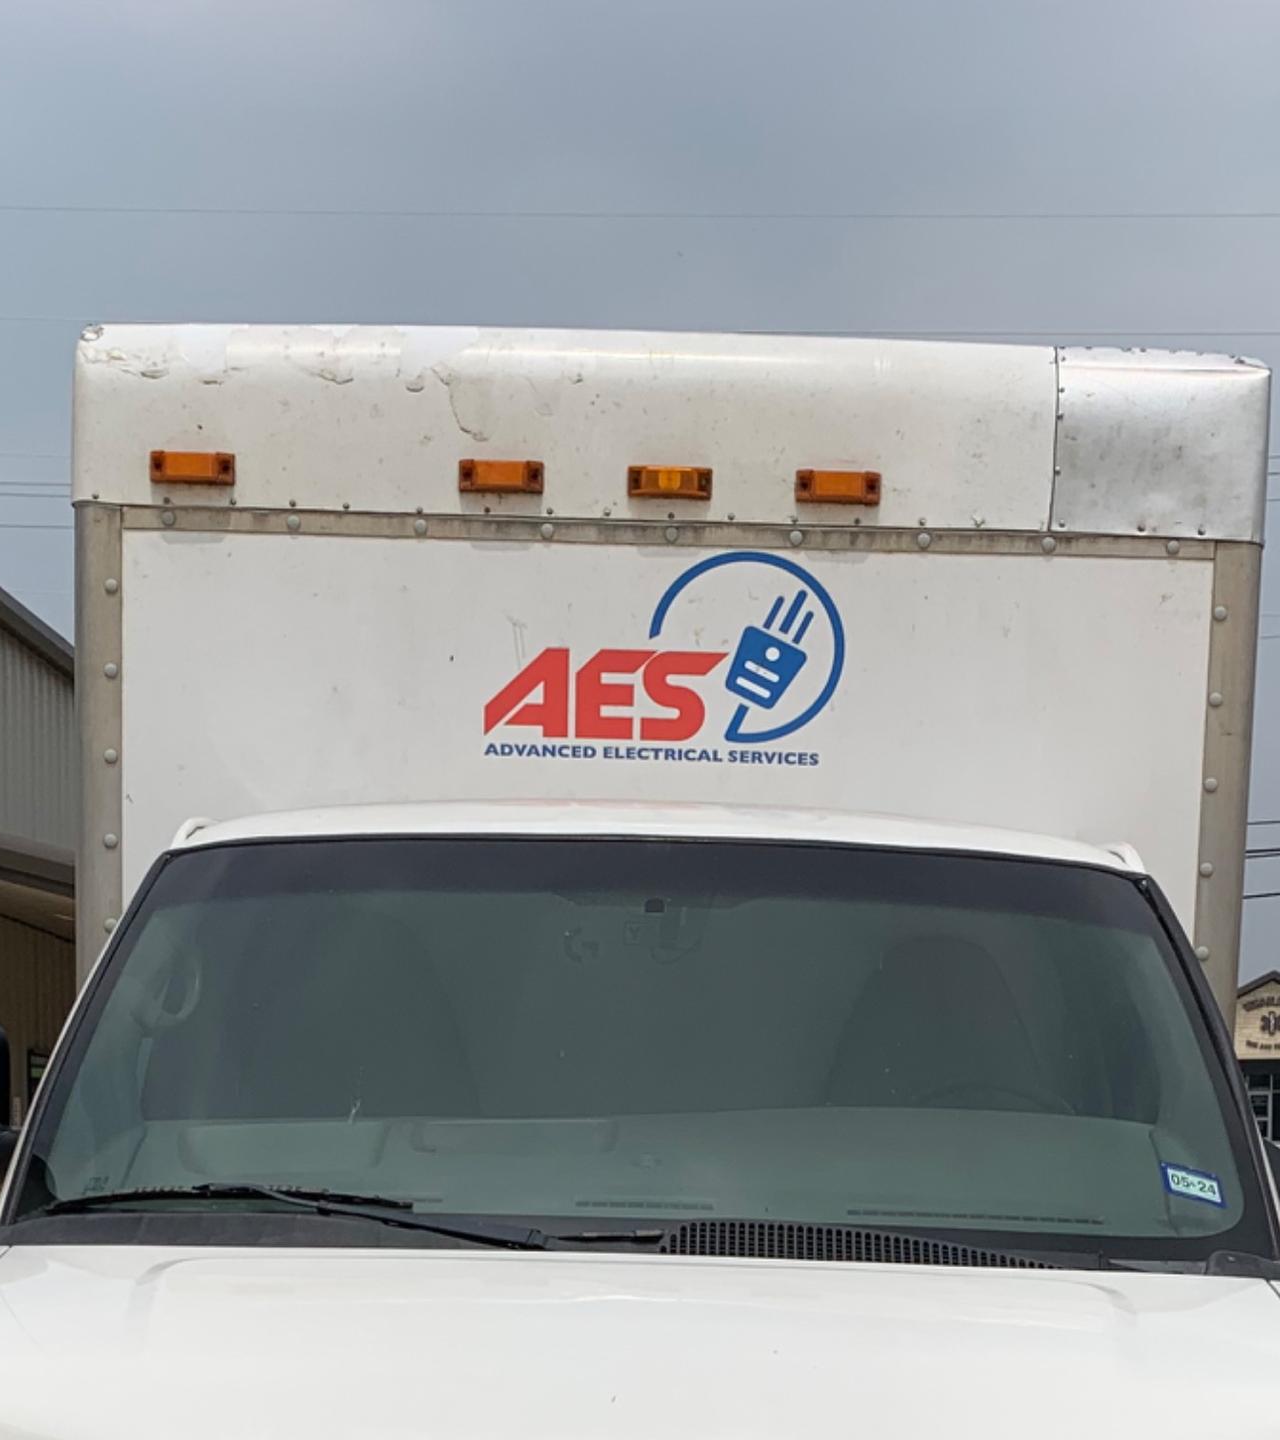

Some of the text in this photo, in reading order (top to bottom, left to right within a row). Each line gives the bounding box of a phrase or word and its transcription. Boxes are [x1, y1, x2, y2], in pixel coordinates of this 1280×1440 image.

[484, 647, 730, 741] AES
[484, 743, 819, 766] ADVANCED ELECTRICAL SERVICES
